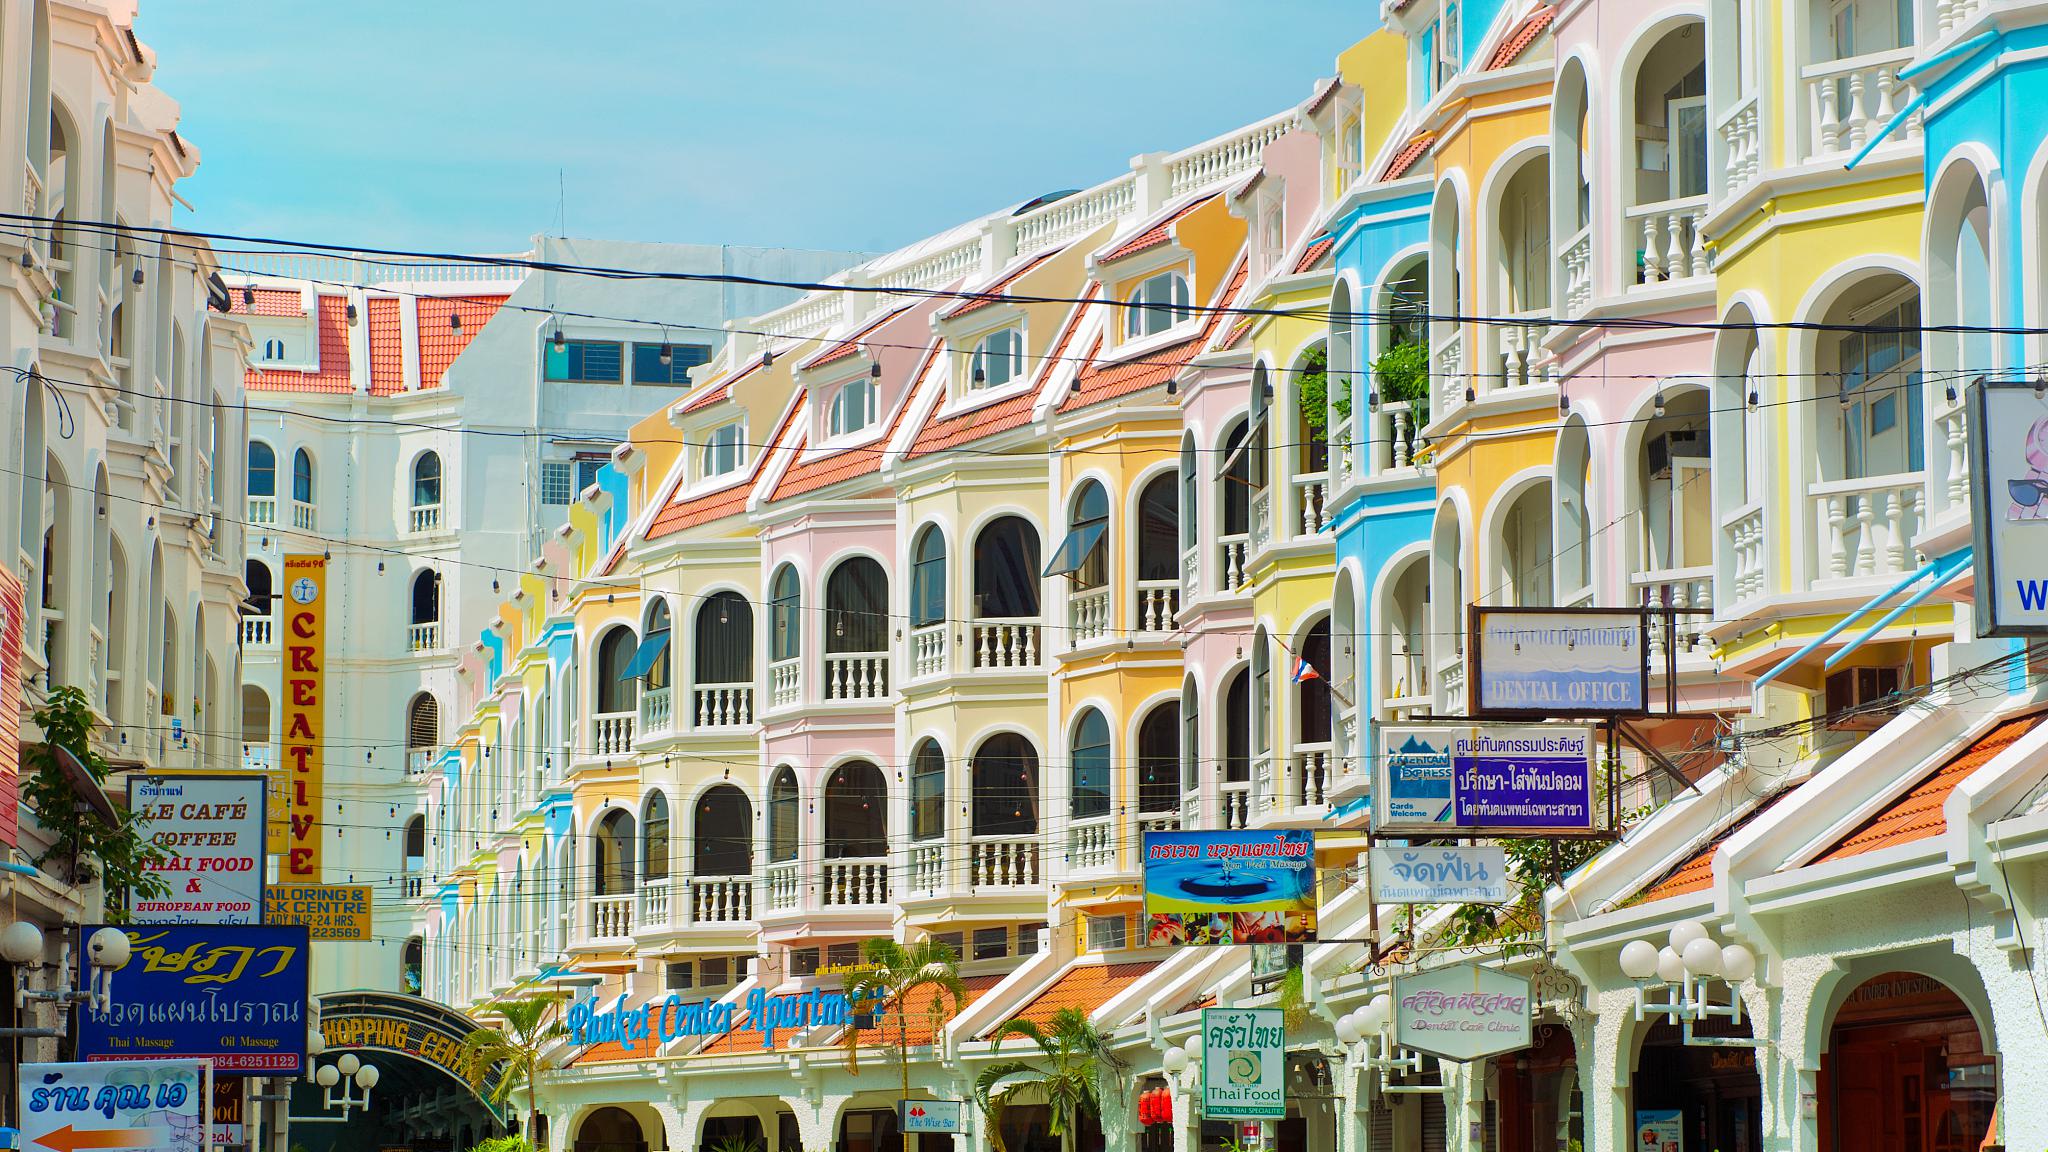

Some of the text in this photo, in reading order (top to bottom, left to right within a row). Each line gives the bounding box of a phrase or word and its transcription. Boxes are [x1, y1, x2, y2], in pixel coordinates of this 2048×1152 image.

[1491, 680, 1631, 702] DENTAL OFFICE
[289, 612, 319, 874] CREATIVE
[1388, 754, 1450, 766] AMERICAN
[1402, 768, 1453, 779] EXPRESS
[142, 804, 174, 820] LE
[180, 797, 247, 820] CAFÉ
[152, 832, 236, 846] COFFEE
[1207, 835, 1308, 858] นวดแผนไทย
[140, 857, 254, 871] THAI FOOD
[1270, 860, 1307, 872] Massage
[1389, 851, 1489, 882] จัดฟัน
[186, 878, 202, 893] &
[265, 888, 364, 901] AILORING &
[136, 902, 250, 912] EUROPEAN FOOD
[265, 901, 367, 914] LK CENTRE
[265, 914, 289, 925] EADY
[334, 915, 357, 927] HRS.
[88, 987, 299, 1027] นวดแผนโบราณ
[567, 993, 651, 1050] Phuket
[658, 994, 737, 1043] Center
[1410, 1019, 1520, 1032] Dental Care Clinic
[322, 1018, 409, 1048] HOPPING
[1208, 1013, 1284, 1049] ครัวไทย
[108, 1036, 280, 1049] Thai Massage Oil Massage
[29, 1072, 90, 1112] ร้าน
[94, 1083, 150, 1119] คุณ
[155, 1082, 188, 1108] เอ
[1209, 1087, 1280, 1100] Thai Food
[909, 1117, 922, 1127] The
[942, 1118, 956, 1128] Bar
